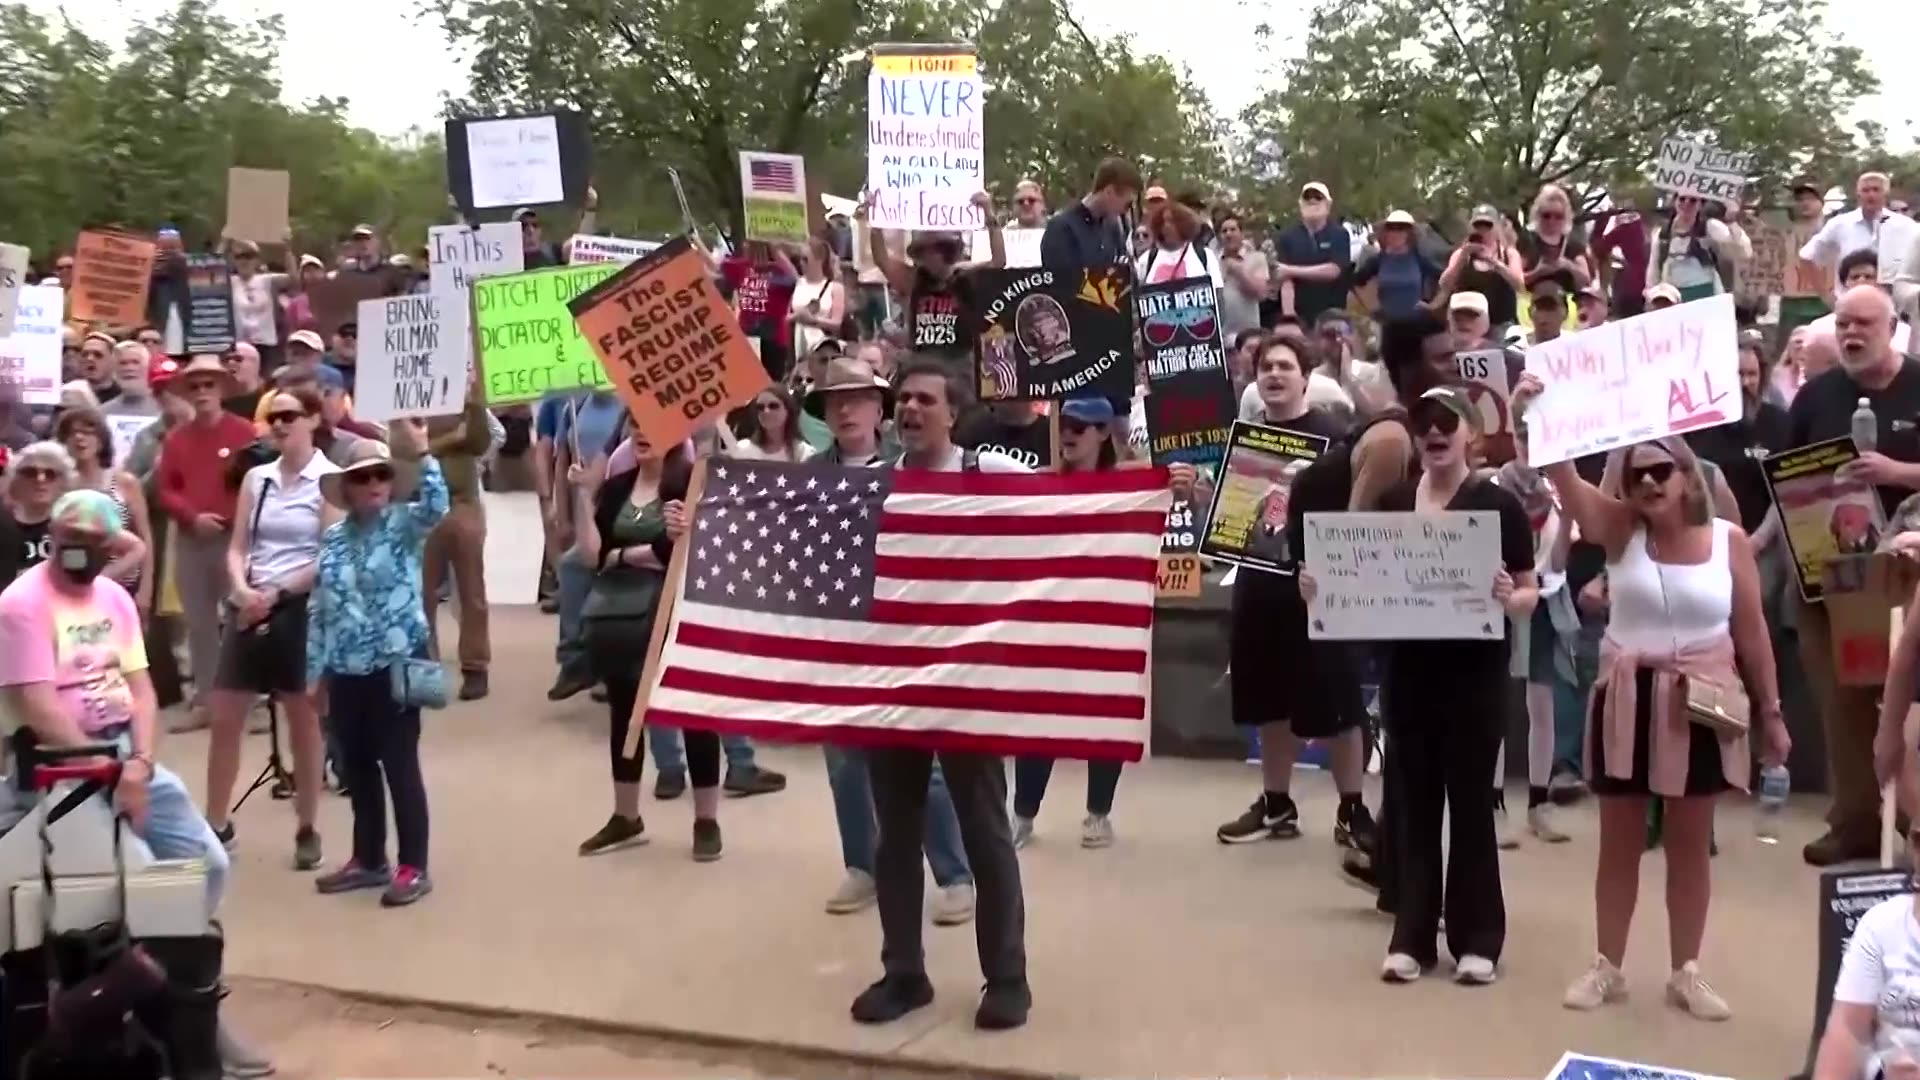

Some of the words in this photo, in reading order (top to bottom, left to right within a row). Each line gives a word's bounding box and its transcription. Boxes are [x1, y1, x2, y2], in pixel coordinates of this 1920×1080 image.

[880, 77, 974, 117] NEVER
[870, 119, 981, 150] Underestimate
[883, 155, 901, 166] AN
[909, 155, 939, 168] OLD
[1663, 143, 1692, 163] NO
[887, 170, 922, 188] WHO
[935, 175, 951, 187] IS
[1657, 168, 1685, 186] NO
[432, 233, 457, 263] In
[459, 230, 503, 262] This
[386, 297, 441, 325] BRING
[476, 280, 538, 311] DITCH
[614, 279, 665, 312] The
[984, 298, 1004, 323] NO
[1003, 271, 1054, 301] KINGS
[1139, 294, 1171, 317] HATE
[598, 278, 707, 355] FASCIST
[916, 313, 958, 325] PROJECT
[385, 322, 440, 352] KILMAR
[479, 318, 563, 352] DICTATOR
[619, 305, 711, 369] TRUMP
[915, 325, 957, 345] 2025
[394, 351, 433, 378] HOME
[628, 323, 732, 394] REGIME
[1029, 384, 1046, 396] IN
[1051, 349, 1121, 395] AMERICA
[1148, 355, 1188, 376] NATION
[1189, 349, 1223, 371] GREAT
[492, 364, 554, 396] EJECT
[654, 352, 727, 408] MUST
[682, 381, 730, 419] GO!
[1668, 371, 1728, 421] ALL
[1154, 434, 1178, 452] LIKE
[1181, 431, 1202, 448] IT'S
[1168, 558, 1194, 572] GO
